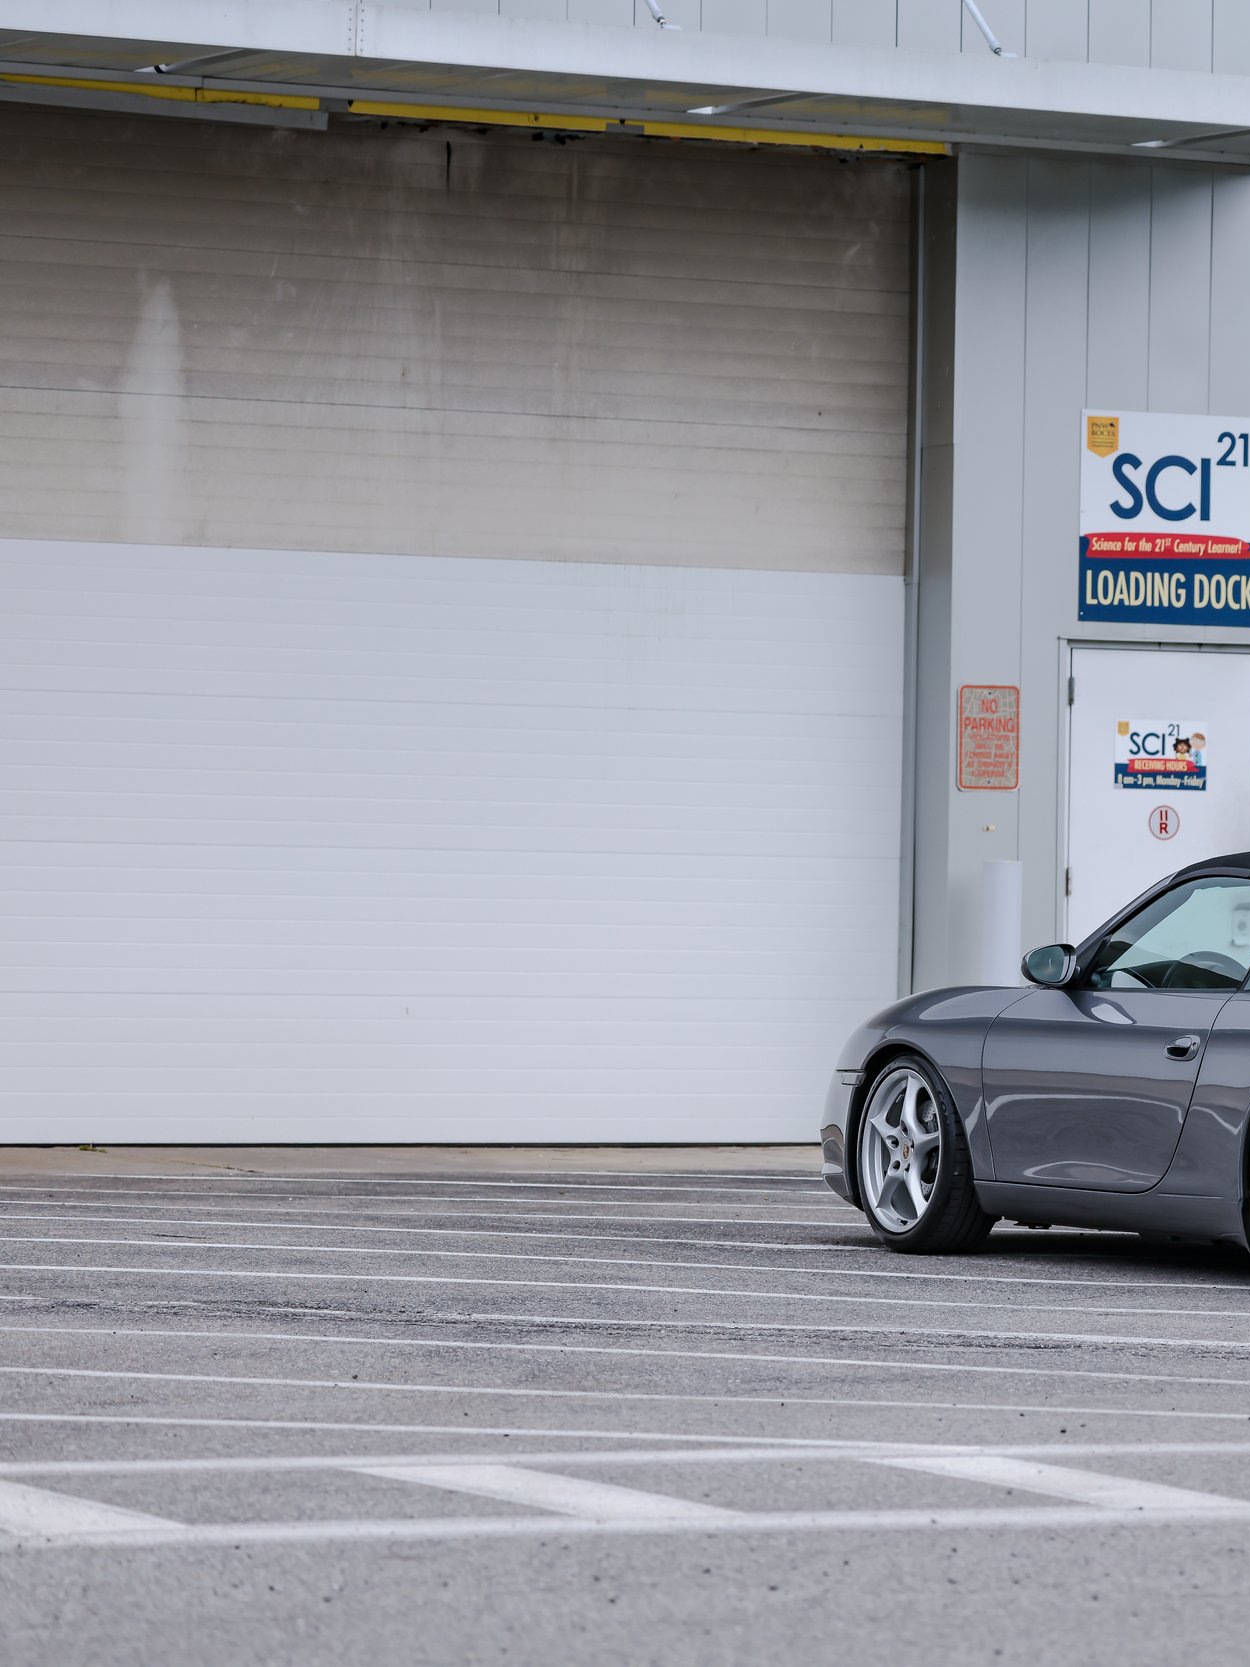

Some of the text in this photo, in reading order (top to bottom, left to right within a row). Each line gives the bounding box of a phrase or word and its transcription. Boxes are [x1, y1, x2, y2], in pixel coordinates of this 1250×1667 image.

[1092, 536, 1122, 551] Science
[1124, 536, 1137, 551] for
[1138, 537, 1153, 552] the
[1173, 539, 1206, 556] Century
[1208, 540, 1242, 554] Learner!
[1085, 569, 1187, 609] LOADING
[981, 698, 998, 714] NO
[964, 716, 1015, 733] PARKING
[1134, 759, 1188, 771] RECEIVING HOURS
[1159, 822, 1169, 834] R
